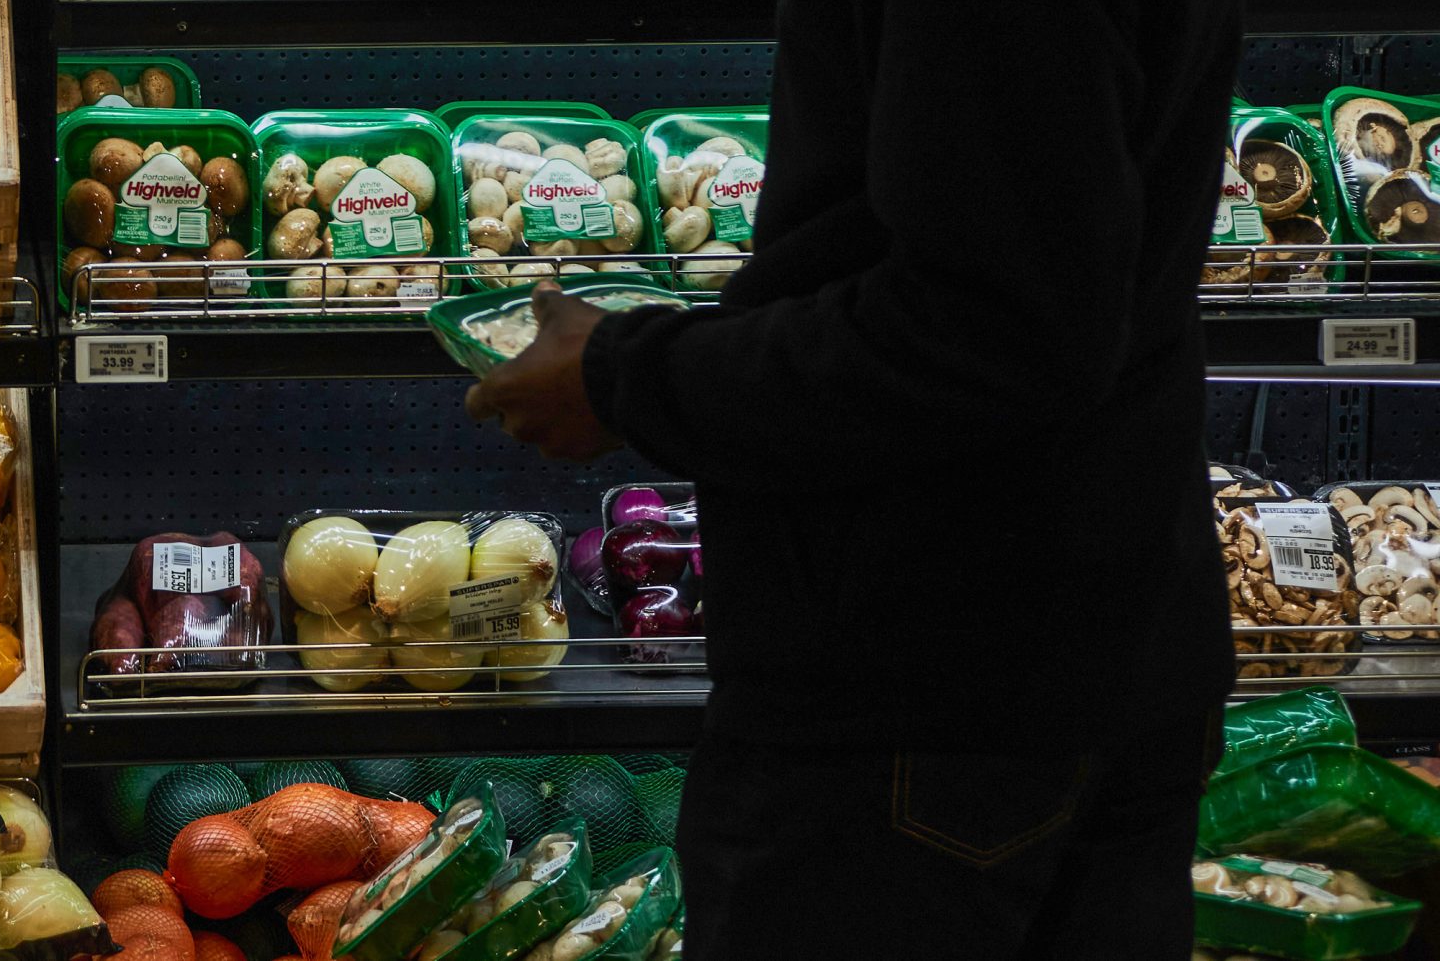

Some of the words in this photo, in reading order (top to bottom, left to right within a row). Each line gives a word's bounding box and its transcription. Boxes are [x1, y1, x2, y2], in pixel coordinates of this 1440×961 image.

[142, 173, 186, 182] Portabellini
[360, 181, 382, 189] White
[126, 181, 202, 201] Highveld
[358, 187, 384, 195] Button
[529, 184, 598, 201] Highveld
[156, 197, 199, 205] Mushrooms
[338, 192, 409, 215] Highveld
[368, 207, 410, 217] Mushrooms
[154, 215, 168, 223] 250
[1347, 341, 1378, 350] 24.99
[102, 357, 134, 367] 33.99
[1310, 554, 1335, 571] 18.99
[171, 571, 186, 591] 15.99
[492, 617, 520, 633] 15.99
[1396, 745, 1430, 753] CLASS
